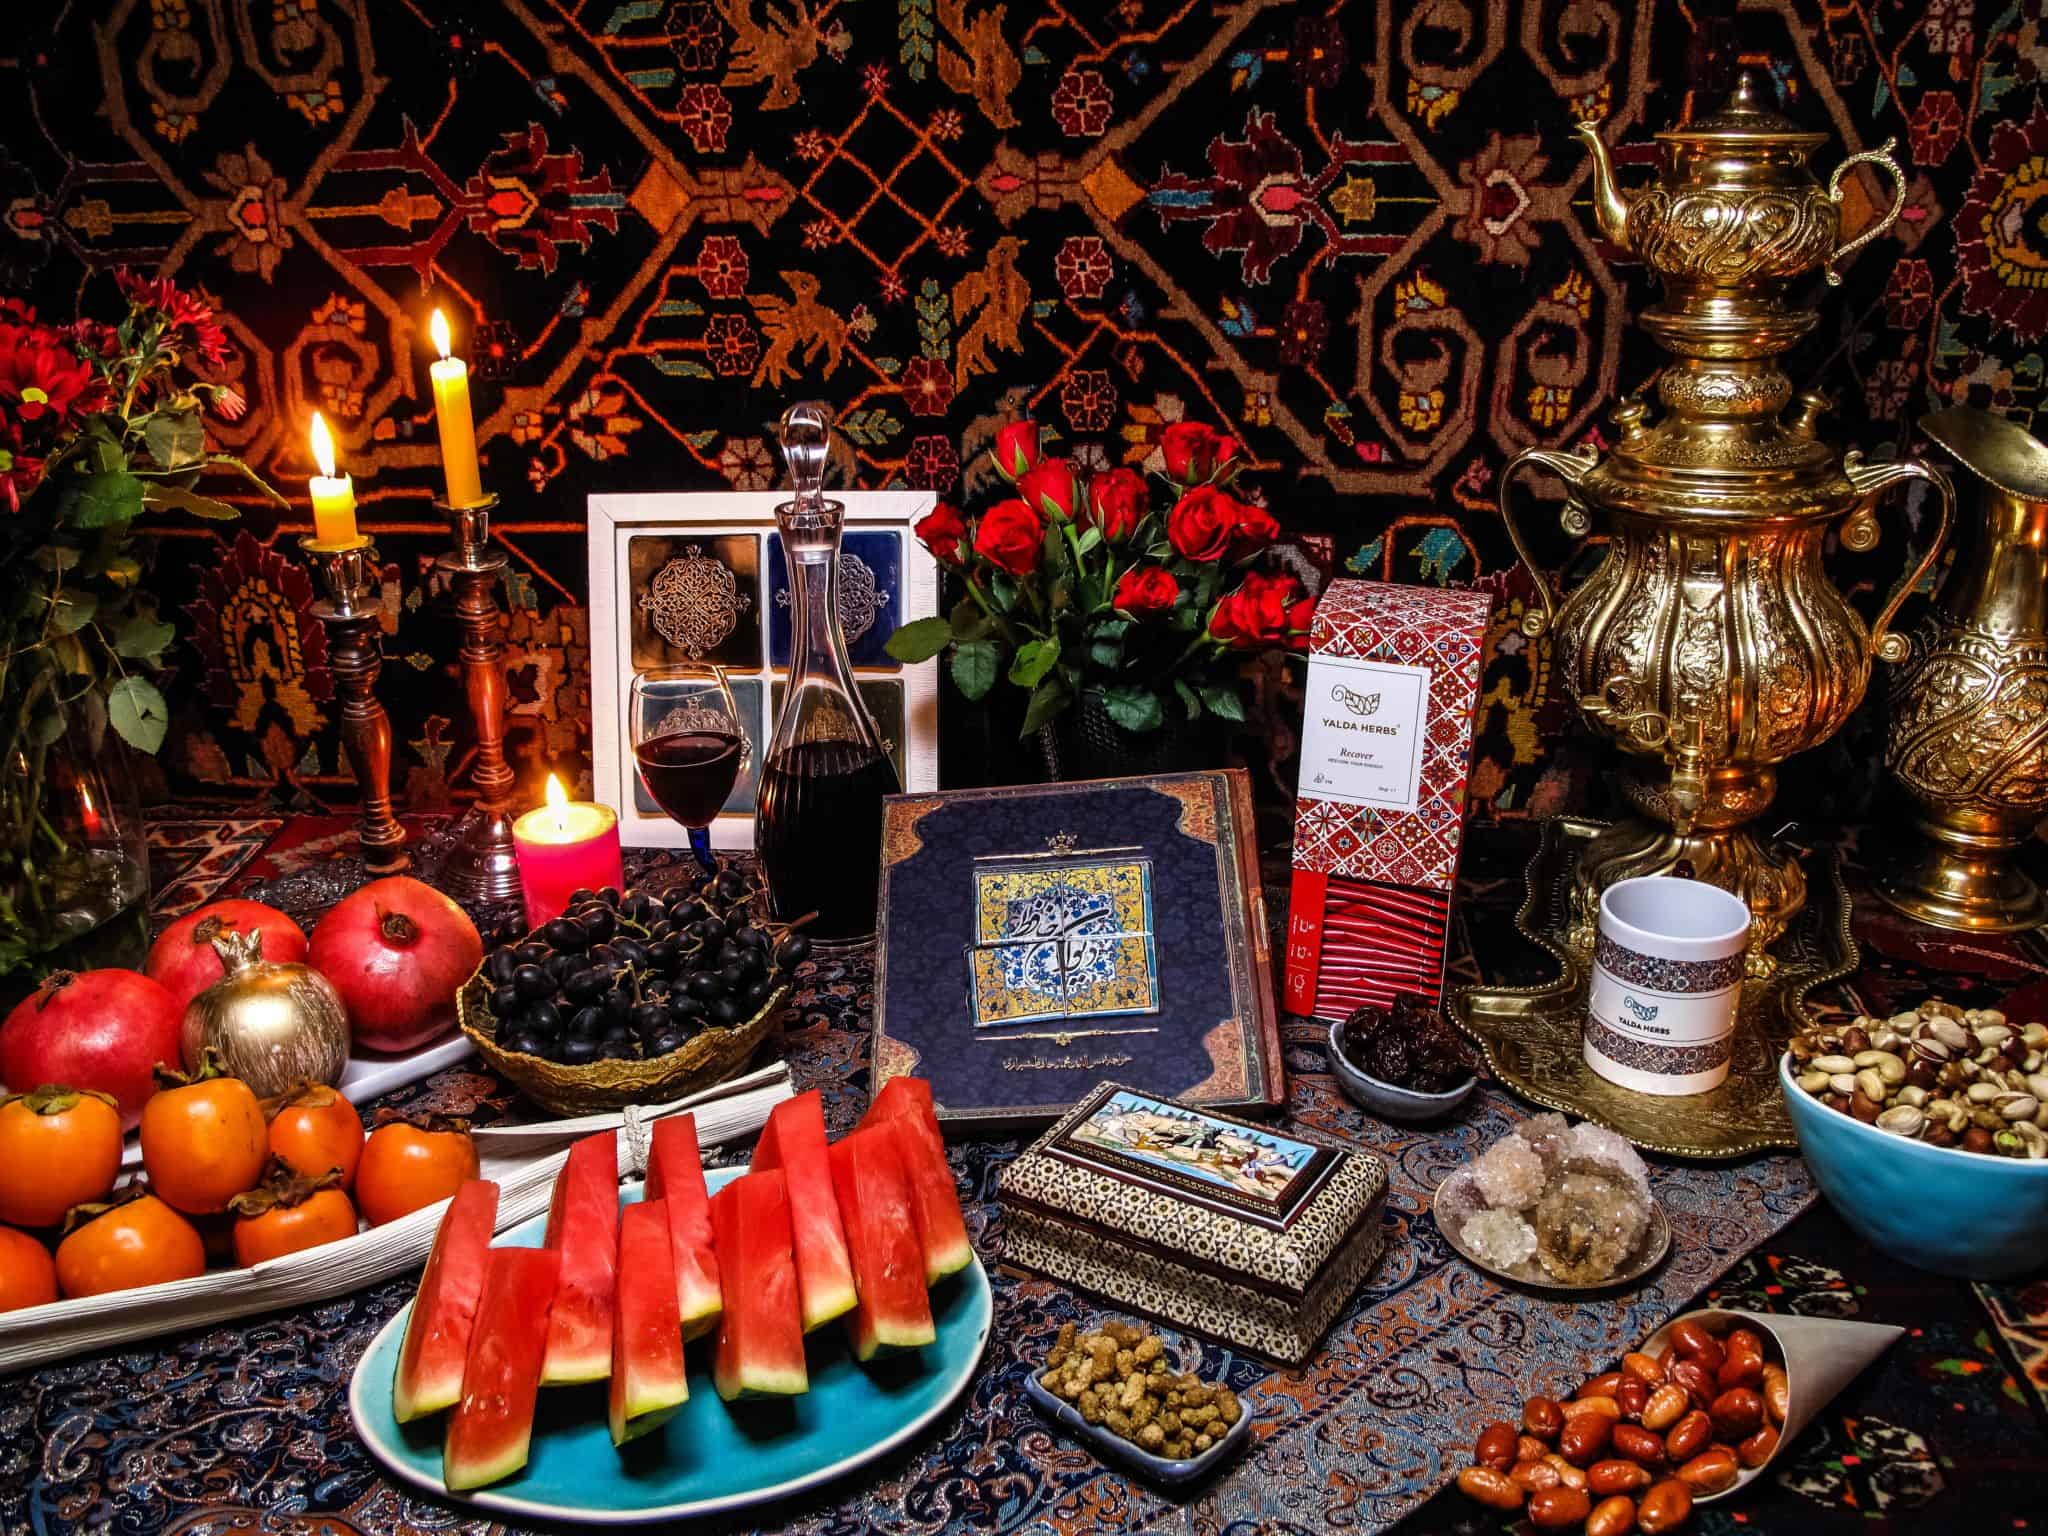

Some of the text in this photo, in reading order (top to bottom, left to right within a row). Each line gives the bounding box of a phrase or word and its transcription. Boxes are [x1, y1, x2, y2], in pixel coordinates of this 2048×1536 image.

[1322, 718, 1398, 737] YALDA HERBS
[1340, 747, 1375, 760] Recover
[1618, 1016, 1670, 1035] YALDA HERBS
